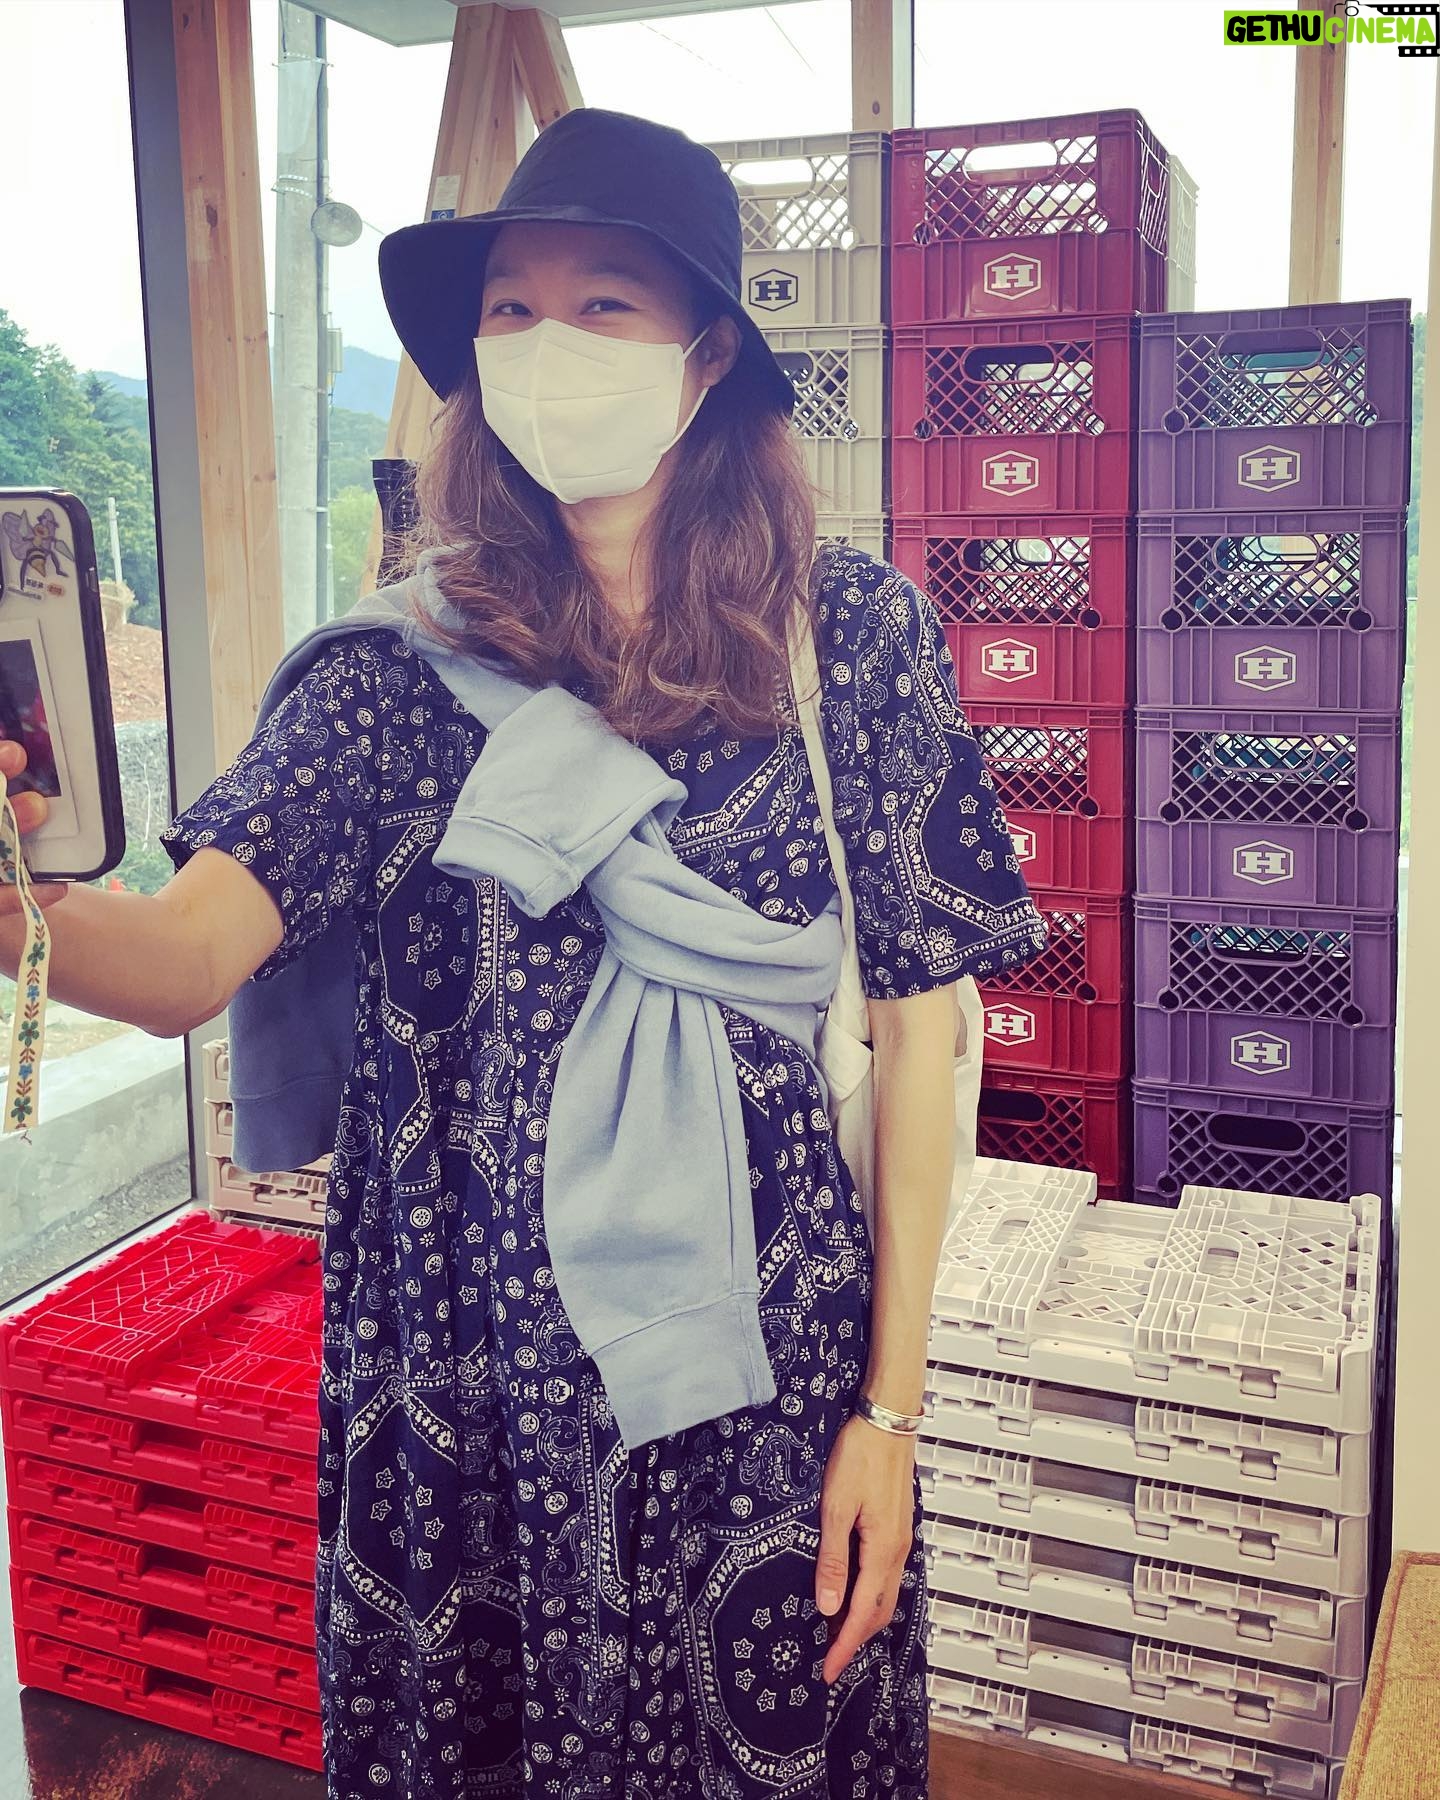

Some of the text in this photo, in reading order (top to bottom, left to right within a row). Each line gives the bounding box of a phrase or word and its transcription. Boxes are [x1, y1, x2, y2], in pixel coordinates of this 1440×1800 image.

[991, 264, 1033, 289] H
[755, 279, 792, 302] H
[990, 462, 1031, 485] H
[1246, 456, 1293, 481] H
[988, 649, 1029, 671] H
[1243, 658, 1288, 681] H
[1241, 851, 1286, 875] H
[988, 1013, 1028, 1036] H
[1239, 1040, 1282, 1065] H
